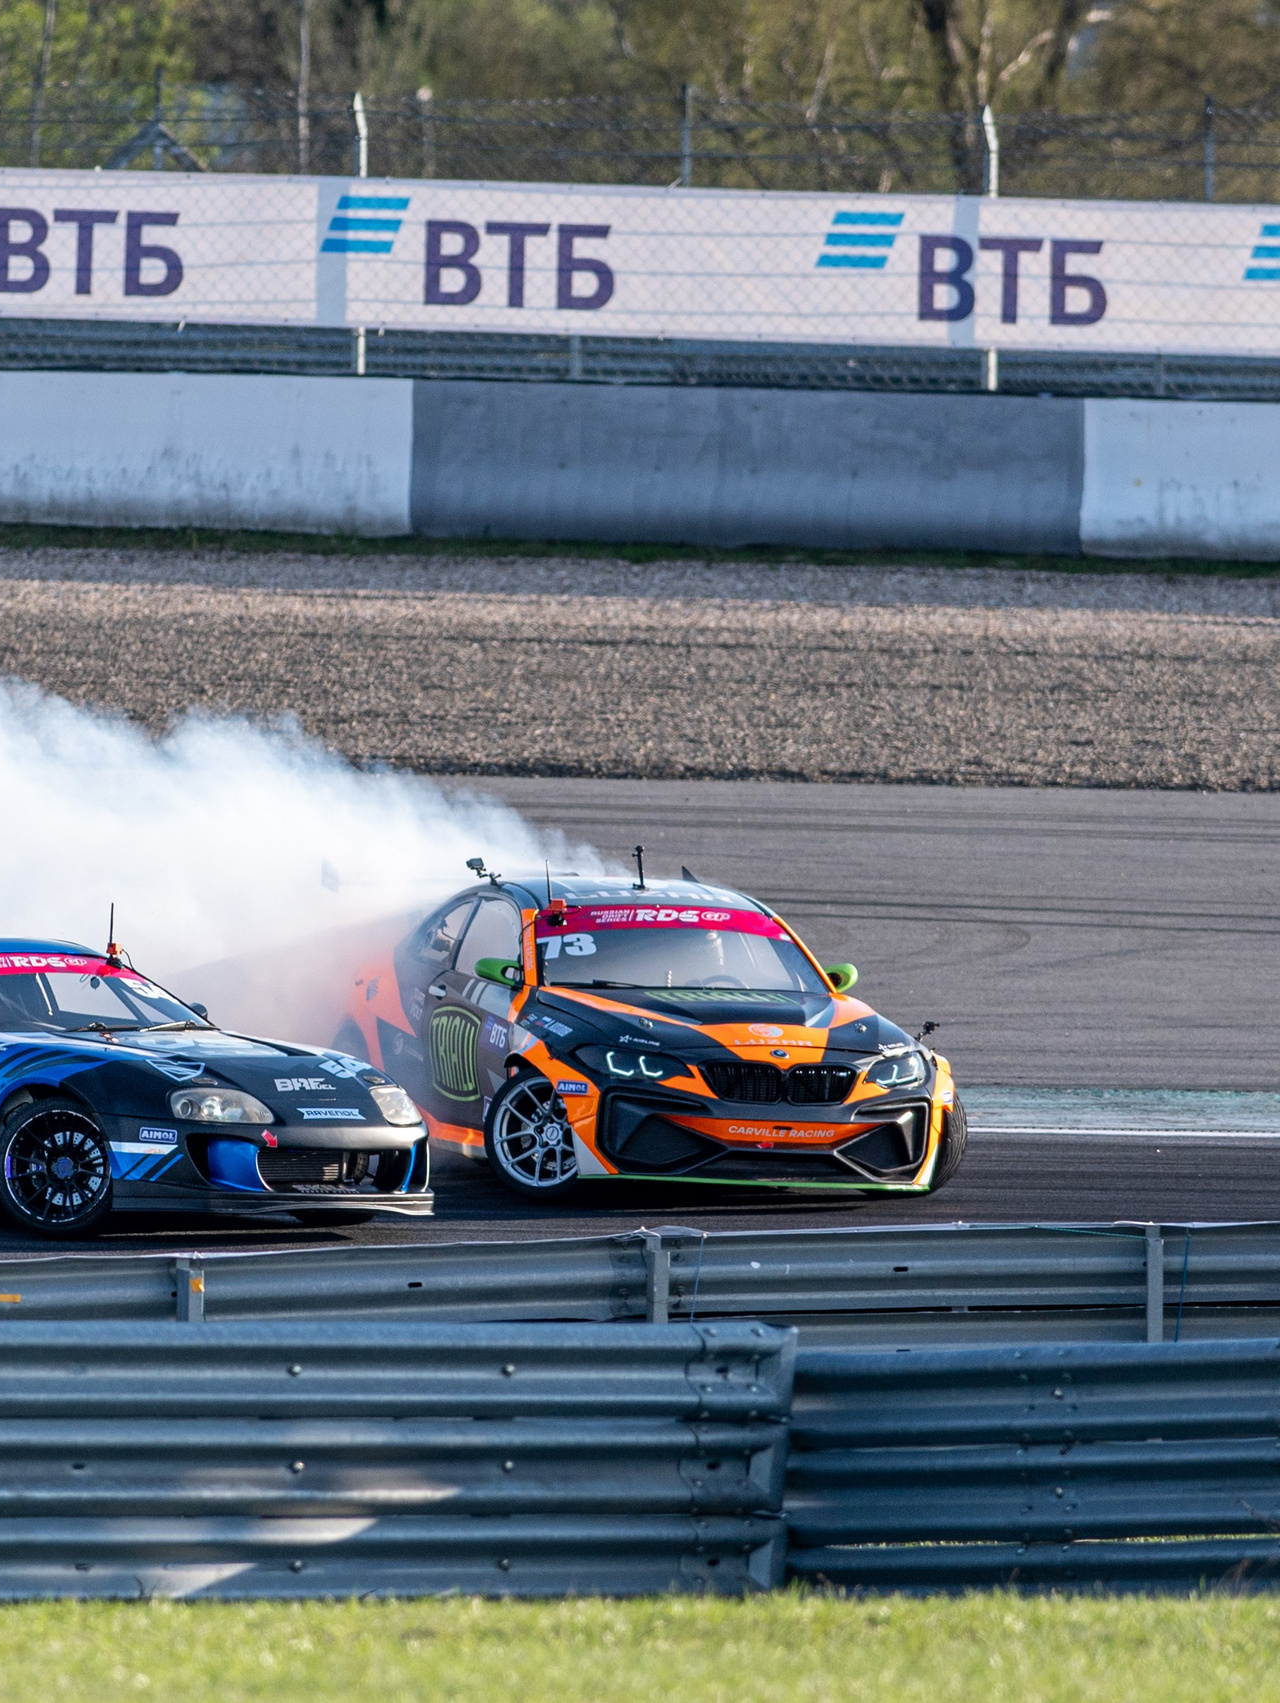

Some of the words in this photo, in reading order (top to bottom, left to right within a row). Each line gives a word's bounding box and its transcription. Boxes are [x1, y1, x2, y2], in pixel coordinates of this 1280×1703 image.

[424, 219, 616, 311] ВТБ
[918, 235, 1108, 326] ВТБ
[635, 909, 701, 922] RDS
[536, 933, 597, 959] 73
[9, 956, 67, 968] RDS
[489, 1023, 508, 1048] ВТБ
[318, 1057, 373, 1079] 54
[557, 1082, 587, 1092] AIMOL
[141, 1129, 175, 1141] AIMOL
[728, 1125, 787, 1137] CARVILLE
[788, 1128, 835, 1138] RACING
